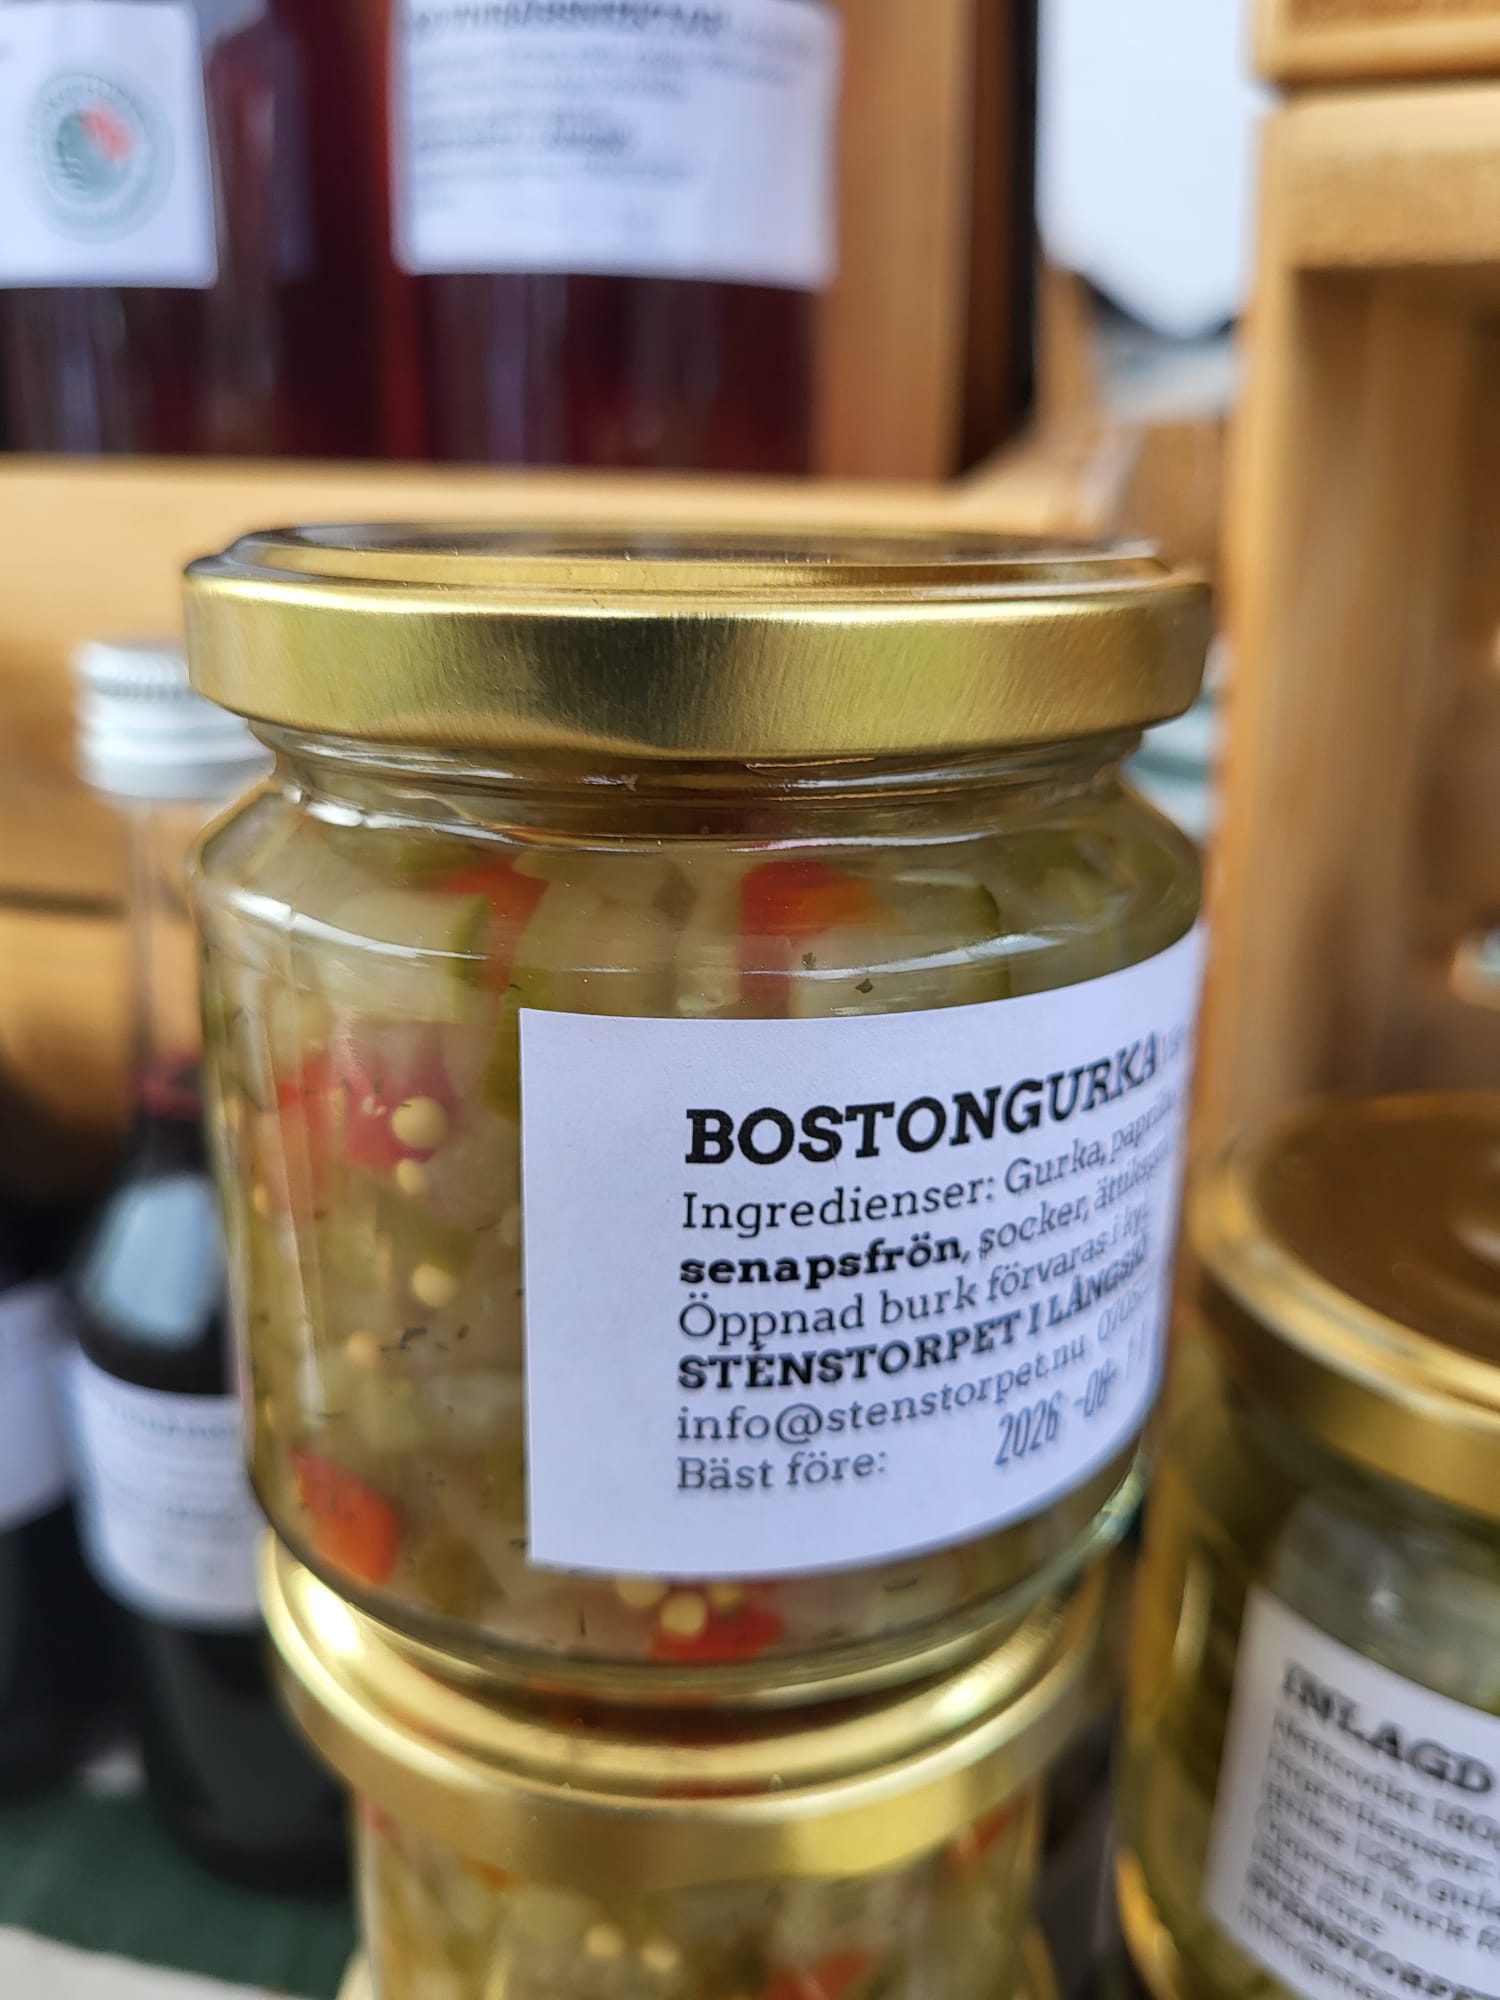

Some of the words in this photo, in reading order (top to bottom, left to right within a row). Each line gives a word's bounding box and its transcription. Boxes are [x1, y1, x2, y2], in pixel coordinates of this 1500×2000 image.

[685, 1029, 1157, 1166] BOSTONGURKA
[682, 1176, 994, 1239] Ingredienser:
[1004, 1138, 1106, 1194] Gurka,
[679, 1231, 966, 1290] senapsfrön,
[979, 1197, 1089, 1262] socker,
[679, 1291, 865, 1346] Öppnad
[879, 1275, 977, 1325] burk
[986, 1230, 1106, 1302] förvaras
[677, 1333, 1086, 1445] info@stenstorpet.nu
[678, 1310, 1022, 1389] STENSTORPET
[1026, 1301, 1042, 1337] I
[677, 1455, 775, 1490] Bäst
[787, 1450, 889, 1487] före:
[994, 1390, 1063, 1465] 2026
